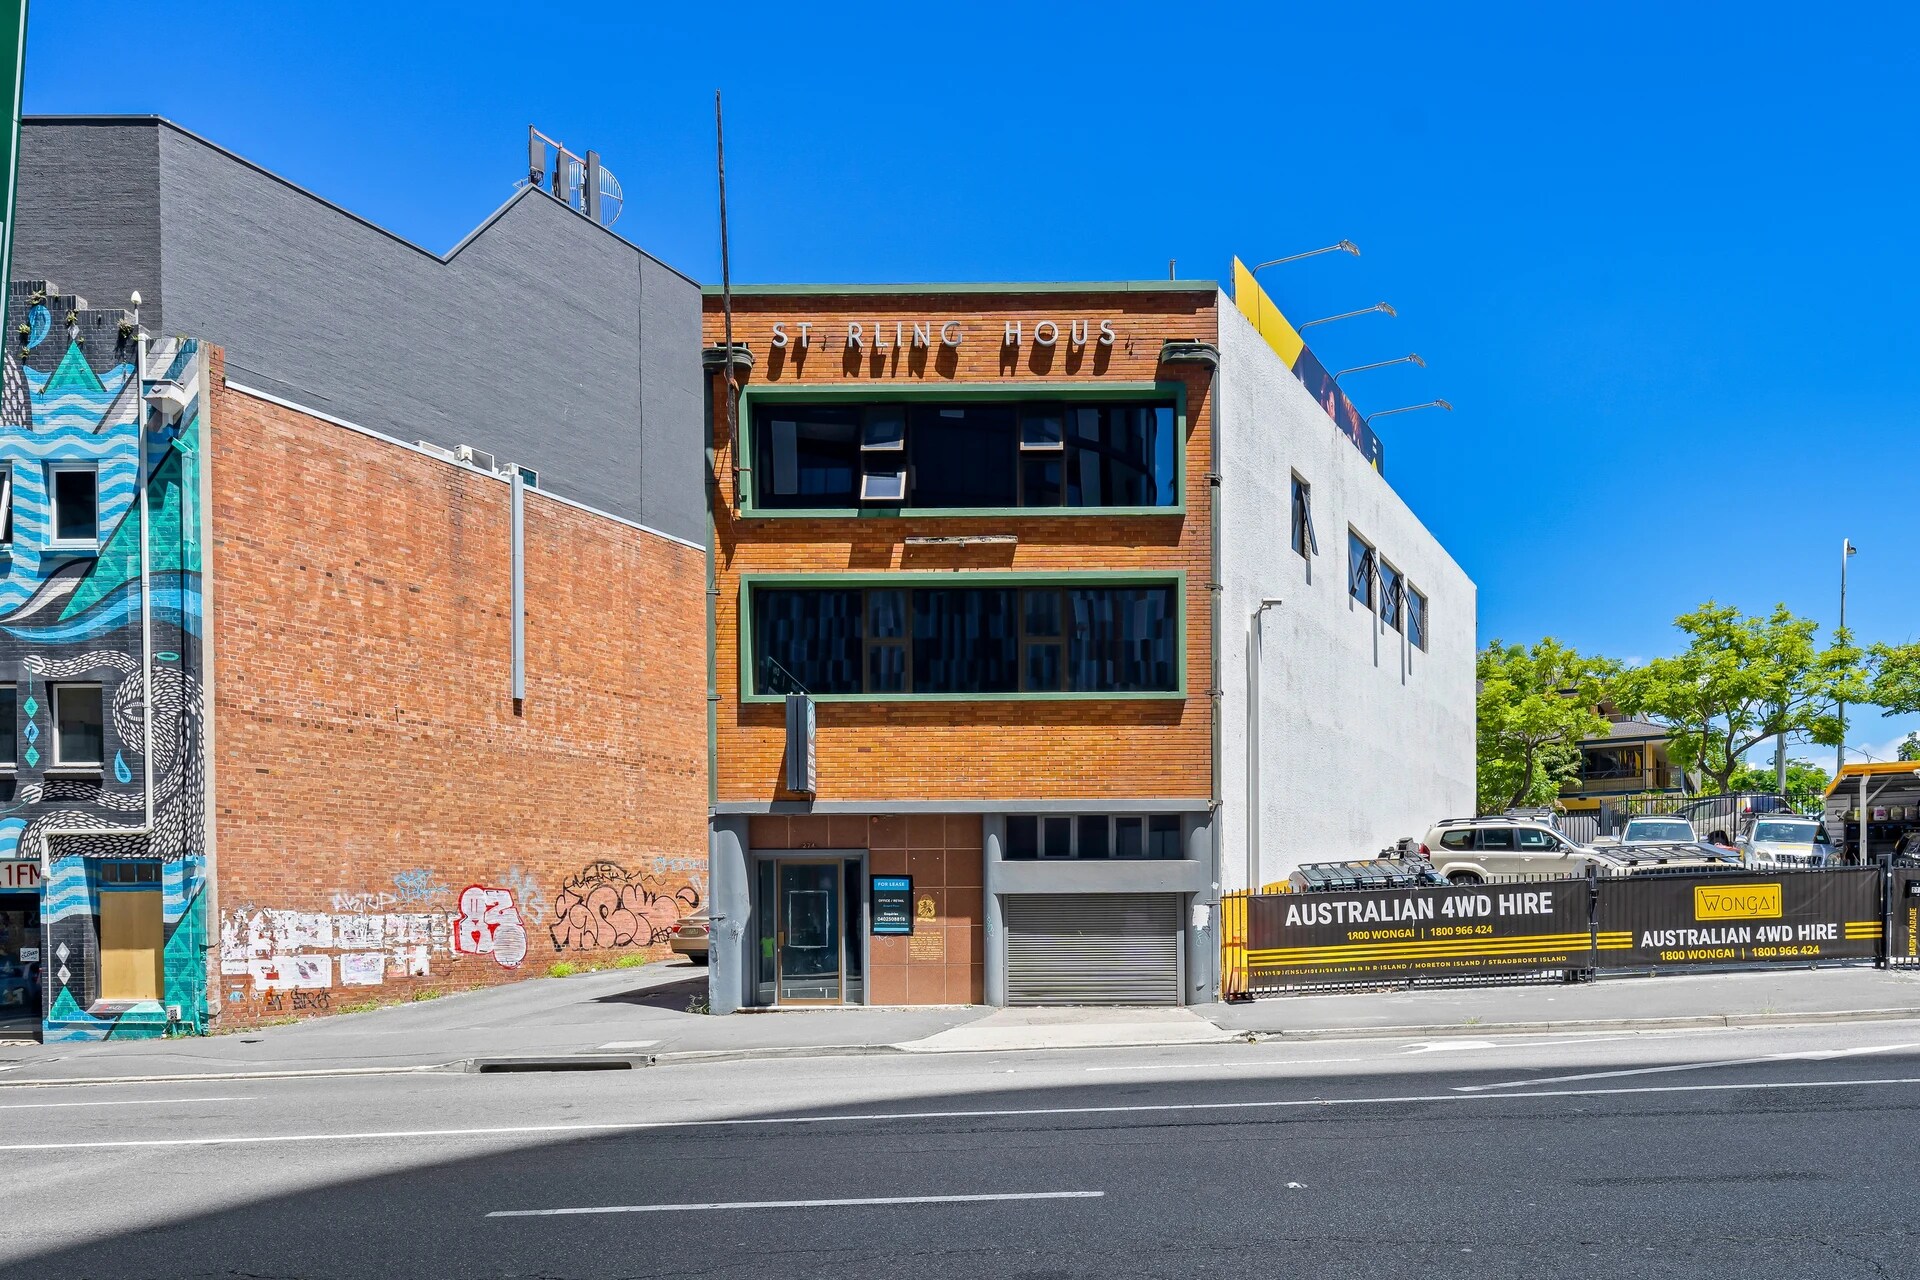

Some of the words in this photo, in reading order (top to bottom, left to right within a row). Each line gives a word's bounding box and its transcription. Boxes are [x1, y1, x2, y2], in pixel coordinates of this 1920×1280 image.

[1285, 897, 1434, 927] AUSTRALIAN
[1441, 895, 1492, 918] 4WD
[1498, 891, 1554, 916] HIRE
[1908, 907, 1917, 933] PARADE
[1347, 931, 1370, 940] 1800
[1371, 928, 1415, 939] WONGAI
[1430, 926, 1454, 936] 1800
[1455, 925, 1473, 935] 966
[1474, 924, 1493, 934] 424
[1640, 927, 1751, 948] AUSTRALIAN
[1755, 925, 1793, 943] 4WD
[1797, 923, 1838, 941] HIRE
[1660, 951, 1685, 961] 1800
[1686, 949, 1735, 960] WONGAI
[1751, 947, 1777, 957] 1800
[1778, 946, 1797, 956] 966
[1800, 945, 1820, 955] 424
[1908, 934, 1917, 956] BARRY
[1415, 961, 1451, 969] MORETON
[1488, 957, 1537, 965] STRADBROKE
[1539, 955, 1567, 963] ISLAND
